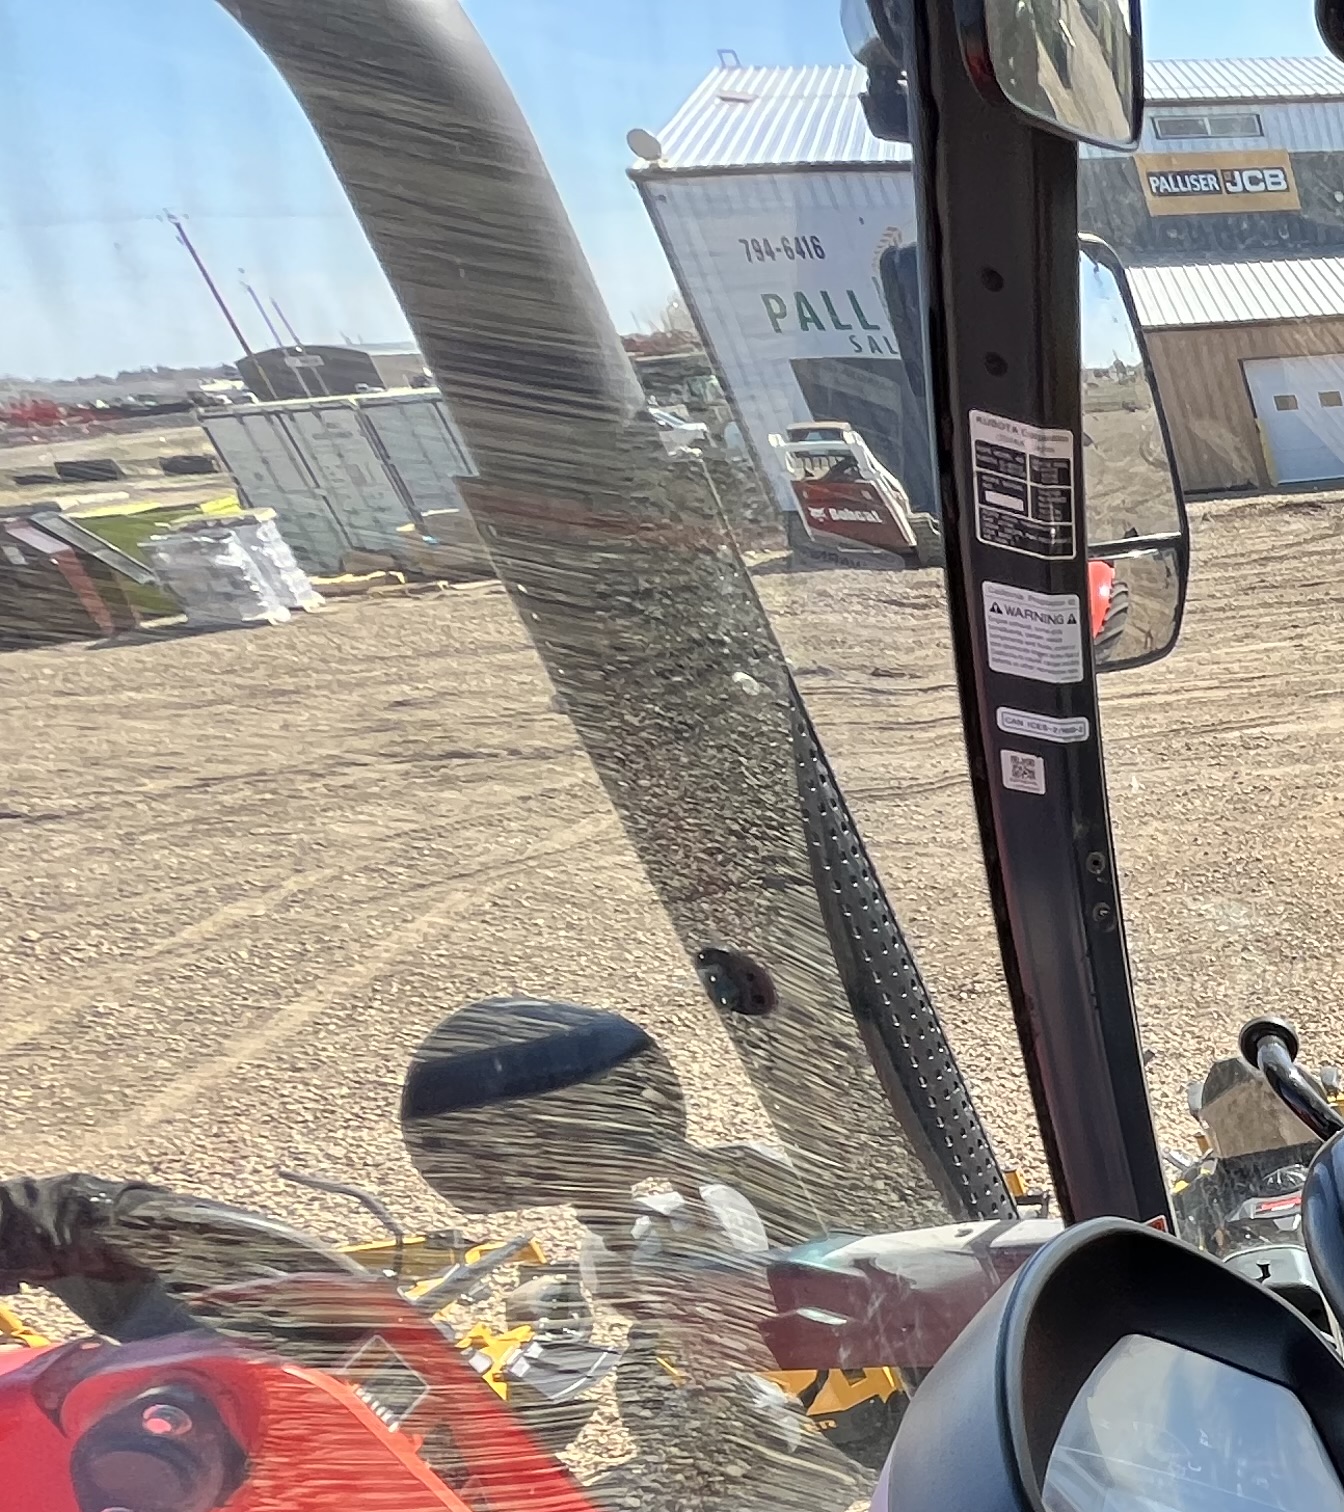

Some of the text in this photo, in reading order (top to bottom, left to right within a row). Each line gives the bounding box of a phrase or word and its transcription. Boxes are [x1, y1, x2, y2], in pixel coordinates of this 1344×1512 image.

[1149, 168, 1288, 194] PALLISER JCB
[738, 235, 826, 263] 794-6416
[828, 507, 883, 524] Bobcat
[1004, 604, 1065, 625] WARNING
